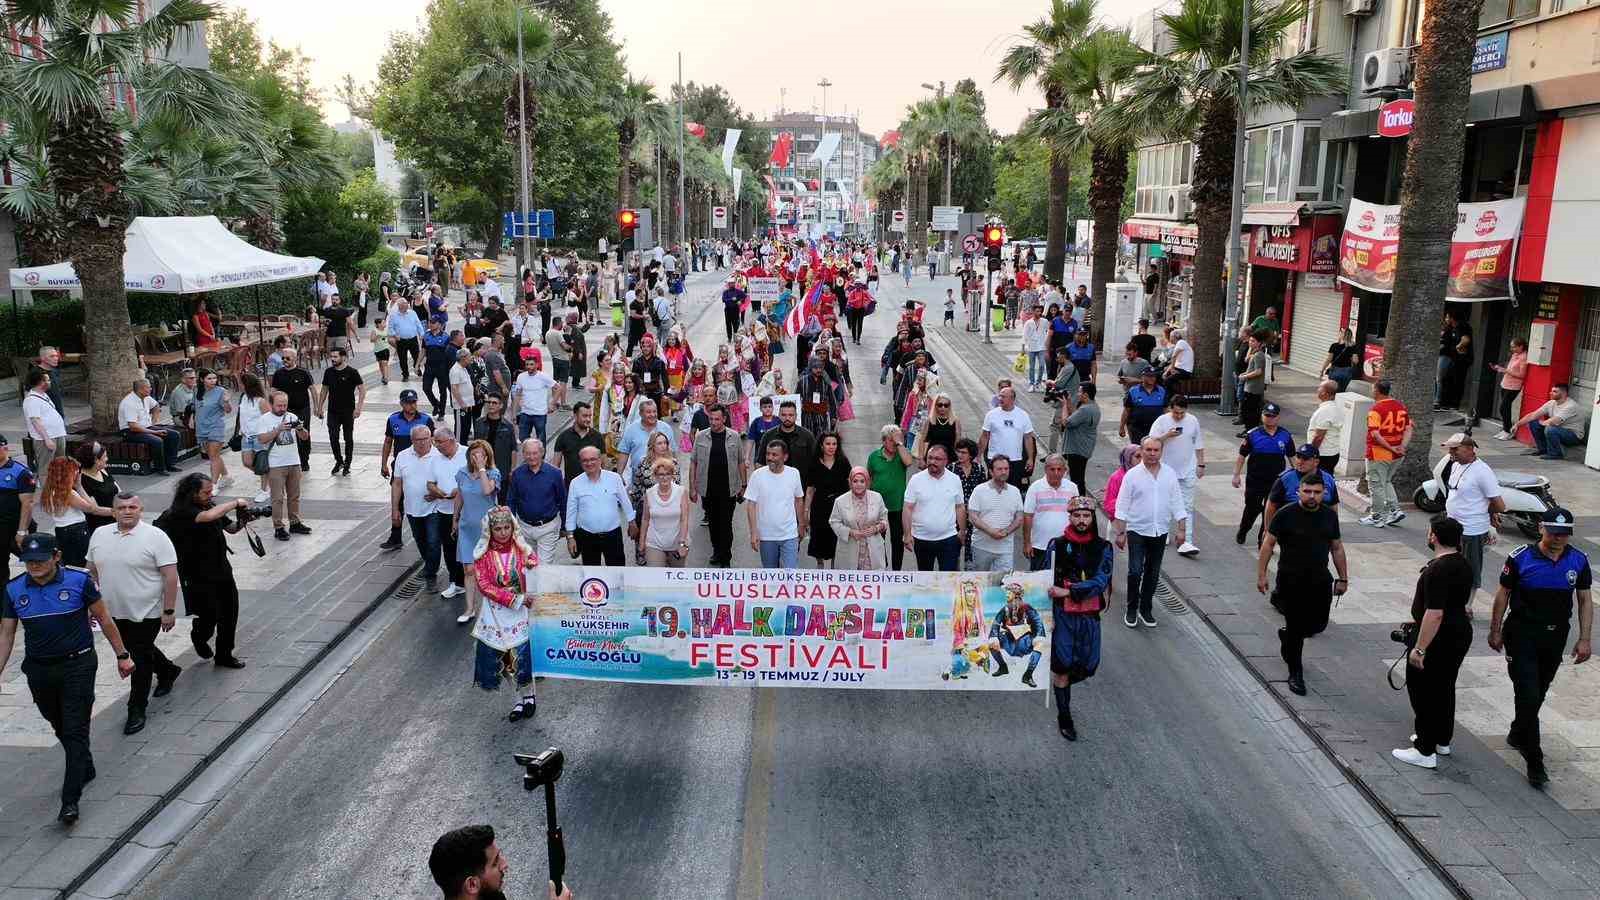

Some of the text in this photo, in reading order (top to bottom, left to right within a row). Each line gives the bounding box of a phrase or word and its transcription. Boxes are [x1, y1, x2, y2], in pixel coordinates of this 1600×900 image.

[1383, 108, 1413, 128] Torku
[1382, 410, 1406, 432] 45
[665, 570, 914, 583] T.C. DENİZLİ BÜYÜKŞEHİR BELEDİYESİ
[697, 583, 881, 600] ULUSLARARASI
[640, 599, 936, 641] 19. HALK DANSLARI
[545, 647, 641, 664] ÇAVUŞOĞLU
[690, 638, 888, 670] FESTİVALİ
[716, 669, 729, 680] 13
[742, 669, 756, 680] 19
[759, 670, 819, 681] TEMMUZ
[832, 671, 865, 682] JULY
